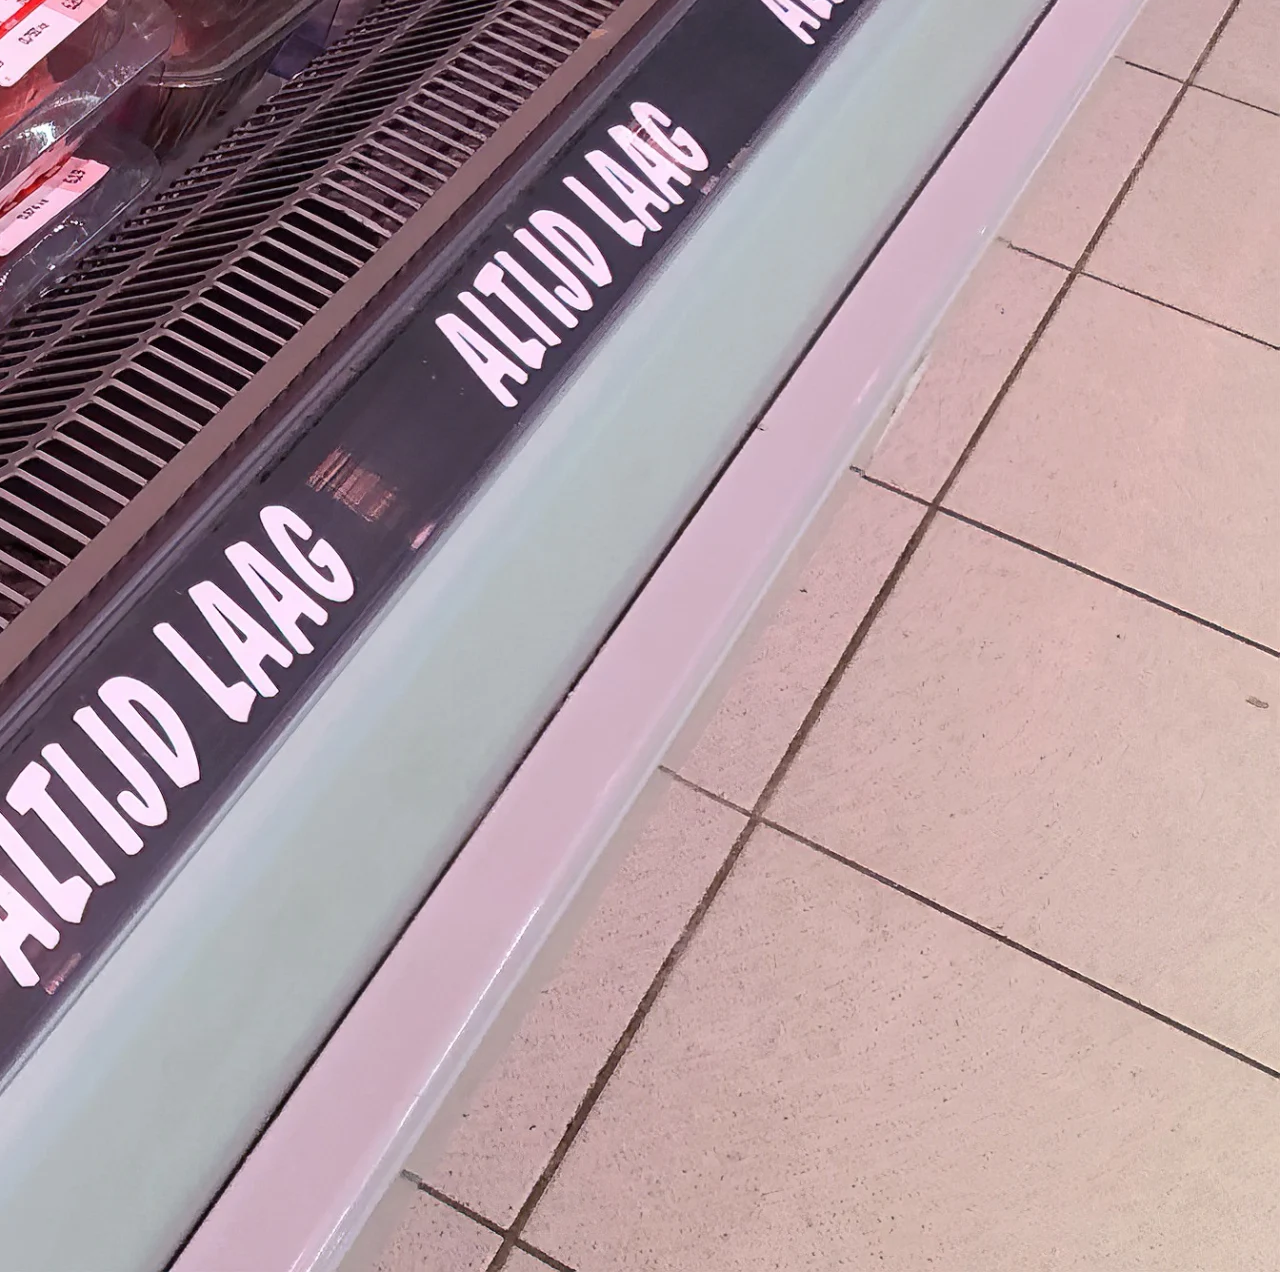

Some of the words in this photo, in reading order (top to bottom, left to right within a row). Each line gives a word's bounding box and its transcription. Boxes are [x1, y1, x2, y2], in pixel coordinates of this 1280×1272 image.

[435, 209, 613, 408] ALTIJD
[562, 101, 710, 248] LAAG
[152, 504, 355, 723] LAAG
